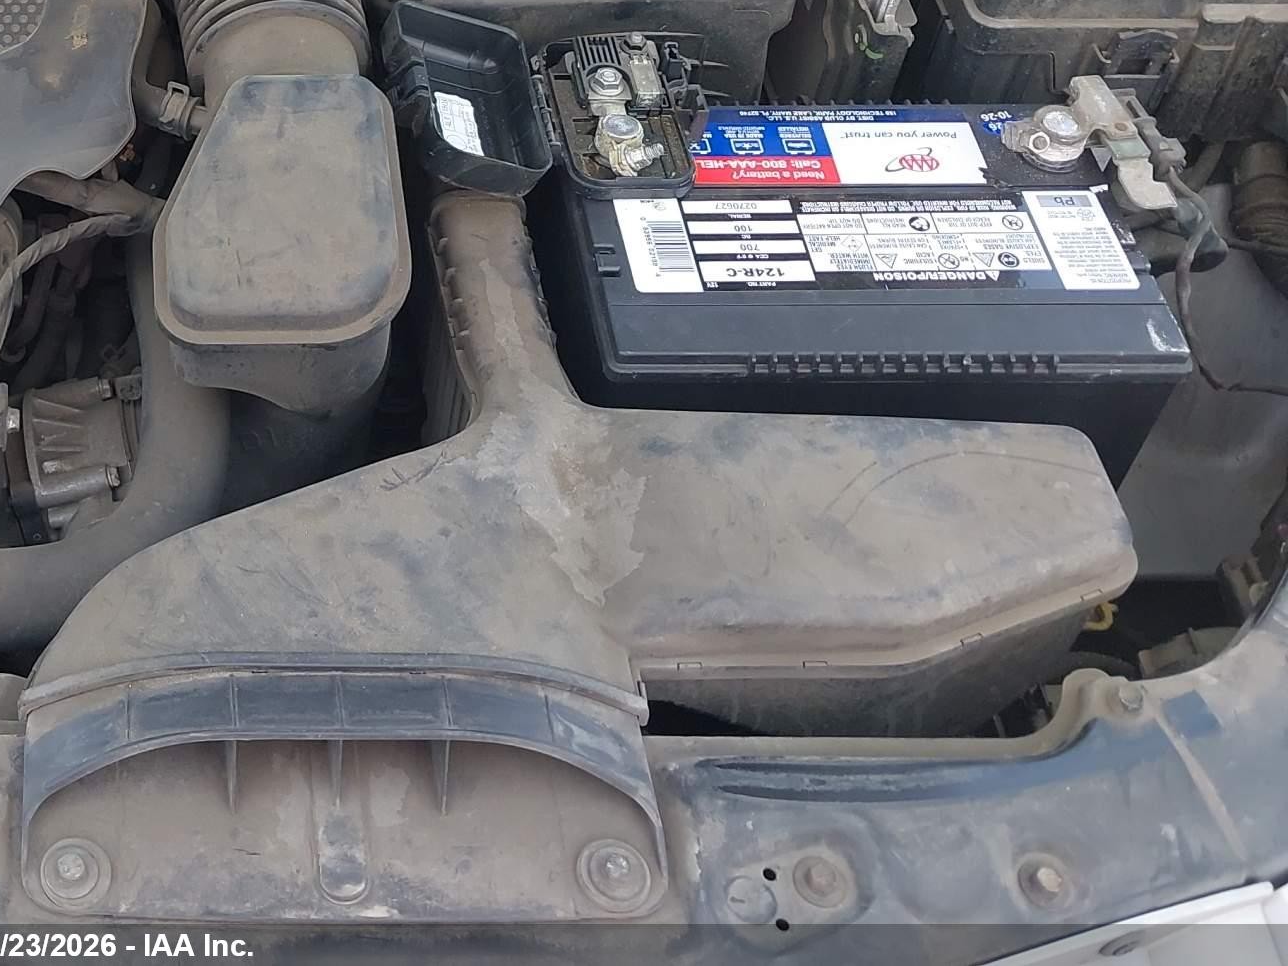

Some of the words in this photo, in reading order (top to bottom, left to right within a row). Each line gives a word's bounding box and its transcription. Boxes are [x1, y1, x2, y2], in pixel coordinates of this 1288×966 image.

[980, 110, 1012, 121] 10-26
[874, 131, 893, 139] can
[896, 130, 918, 139] you
[921, 131, 957, 140] Power
[695, 160, 788, 169] 800-AAA-HEL
[790, 160, 821, 169] Call:
[901, 156, 936, 171] AAA
[733, 169, 781, 180] battery?
[793, 171, 825, 180] Need
[1054, 197, 1075, 206] Pb
[734, 224, 753, 232] 100
[740, 243, 760, 251] 700
[726, 267, 785, 277] 124R-C
[873, 271, 987, 282] DANGER/POISON
